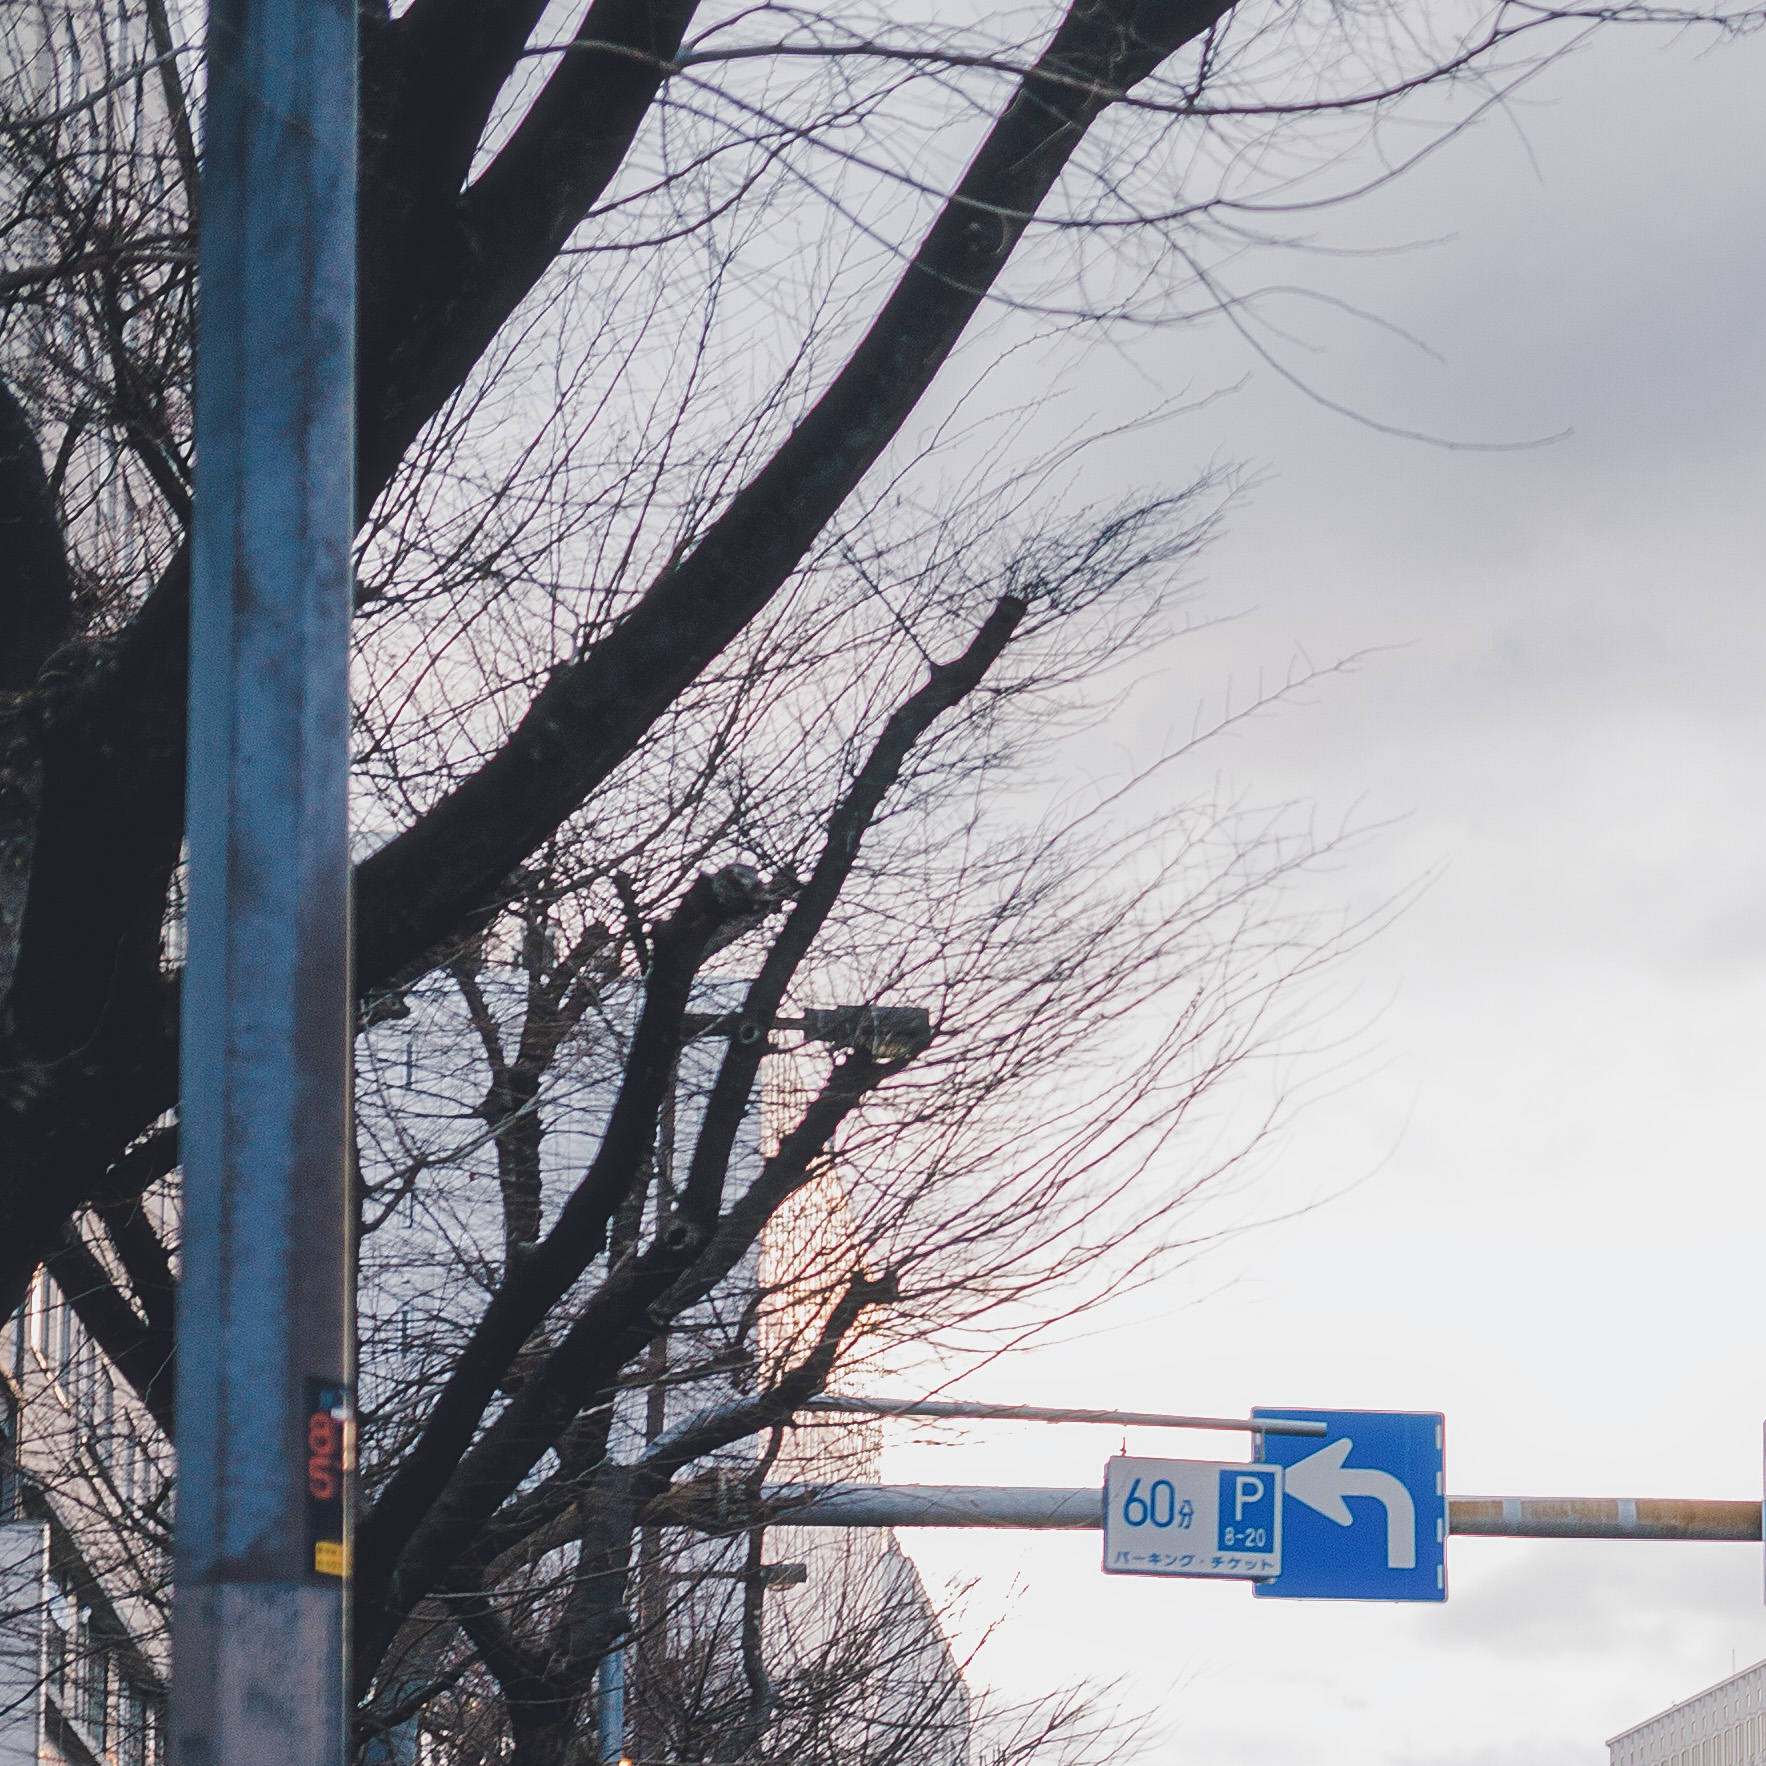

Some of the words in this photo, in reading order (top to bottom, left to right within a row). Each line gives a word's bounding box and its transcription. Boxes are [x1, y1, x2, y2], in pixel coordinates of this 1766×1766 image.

[1123, 1477, 1194, 1531] 60分
[1235, 1476, 1265, 1521] P
[1223, 1528, 1267, 1548] 8-20
[1113, 1550, 1275, 1572] パーキング・チケット
